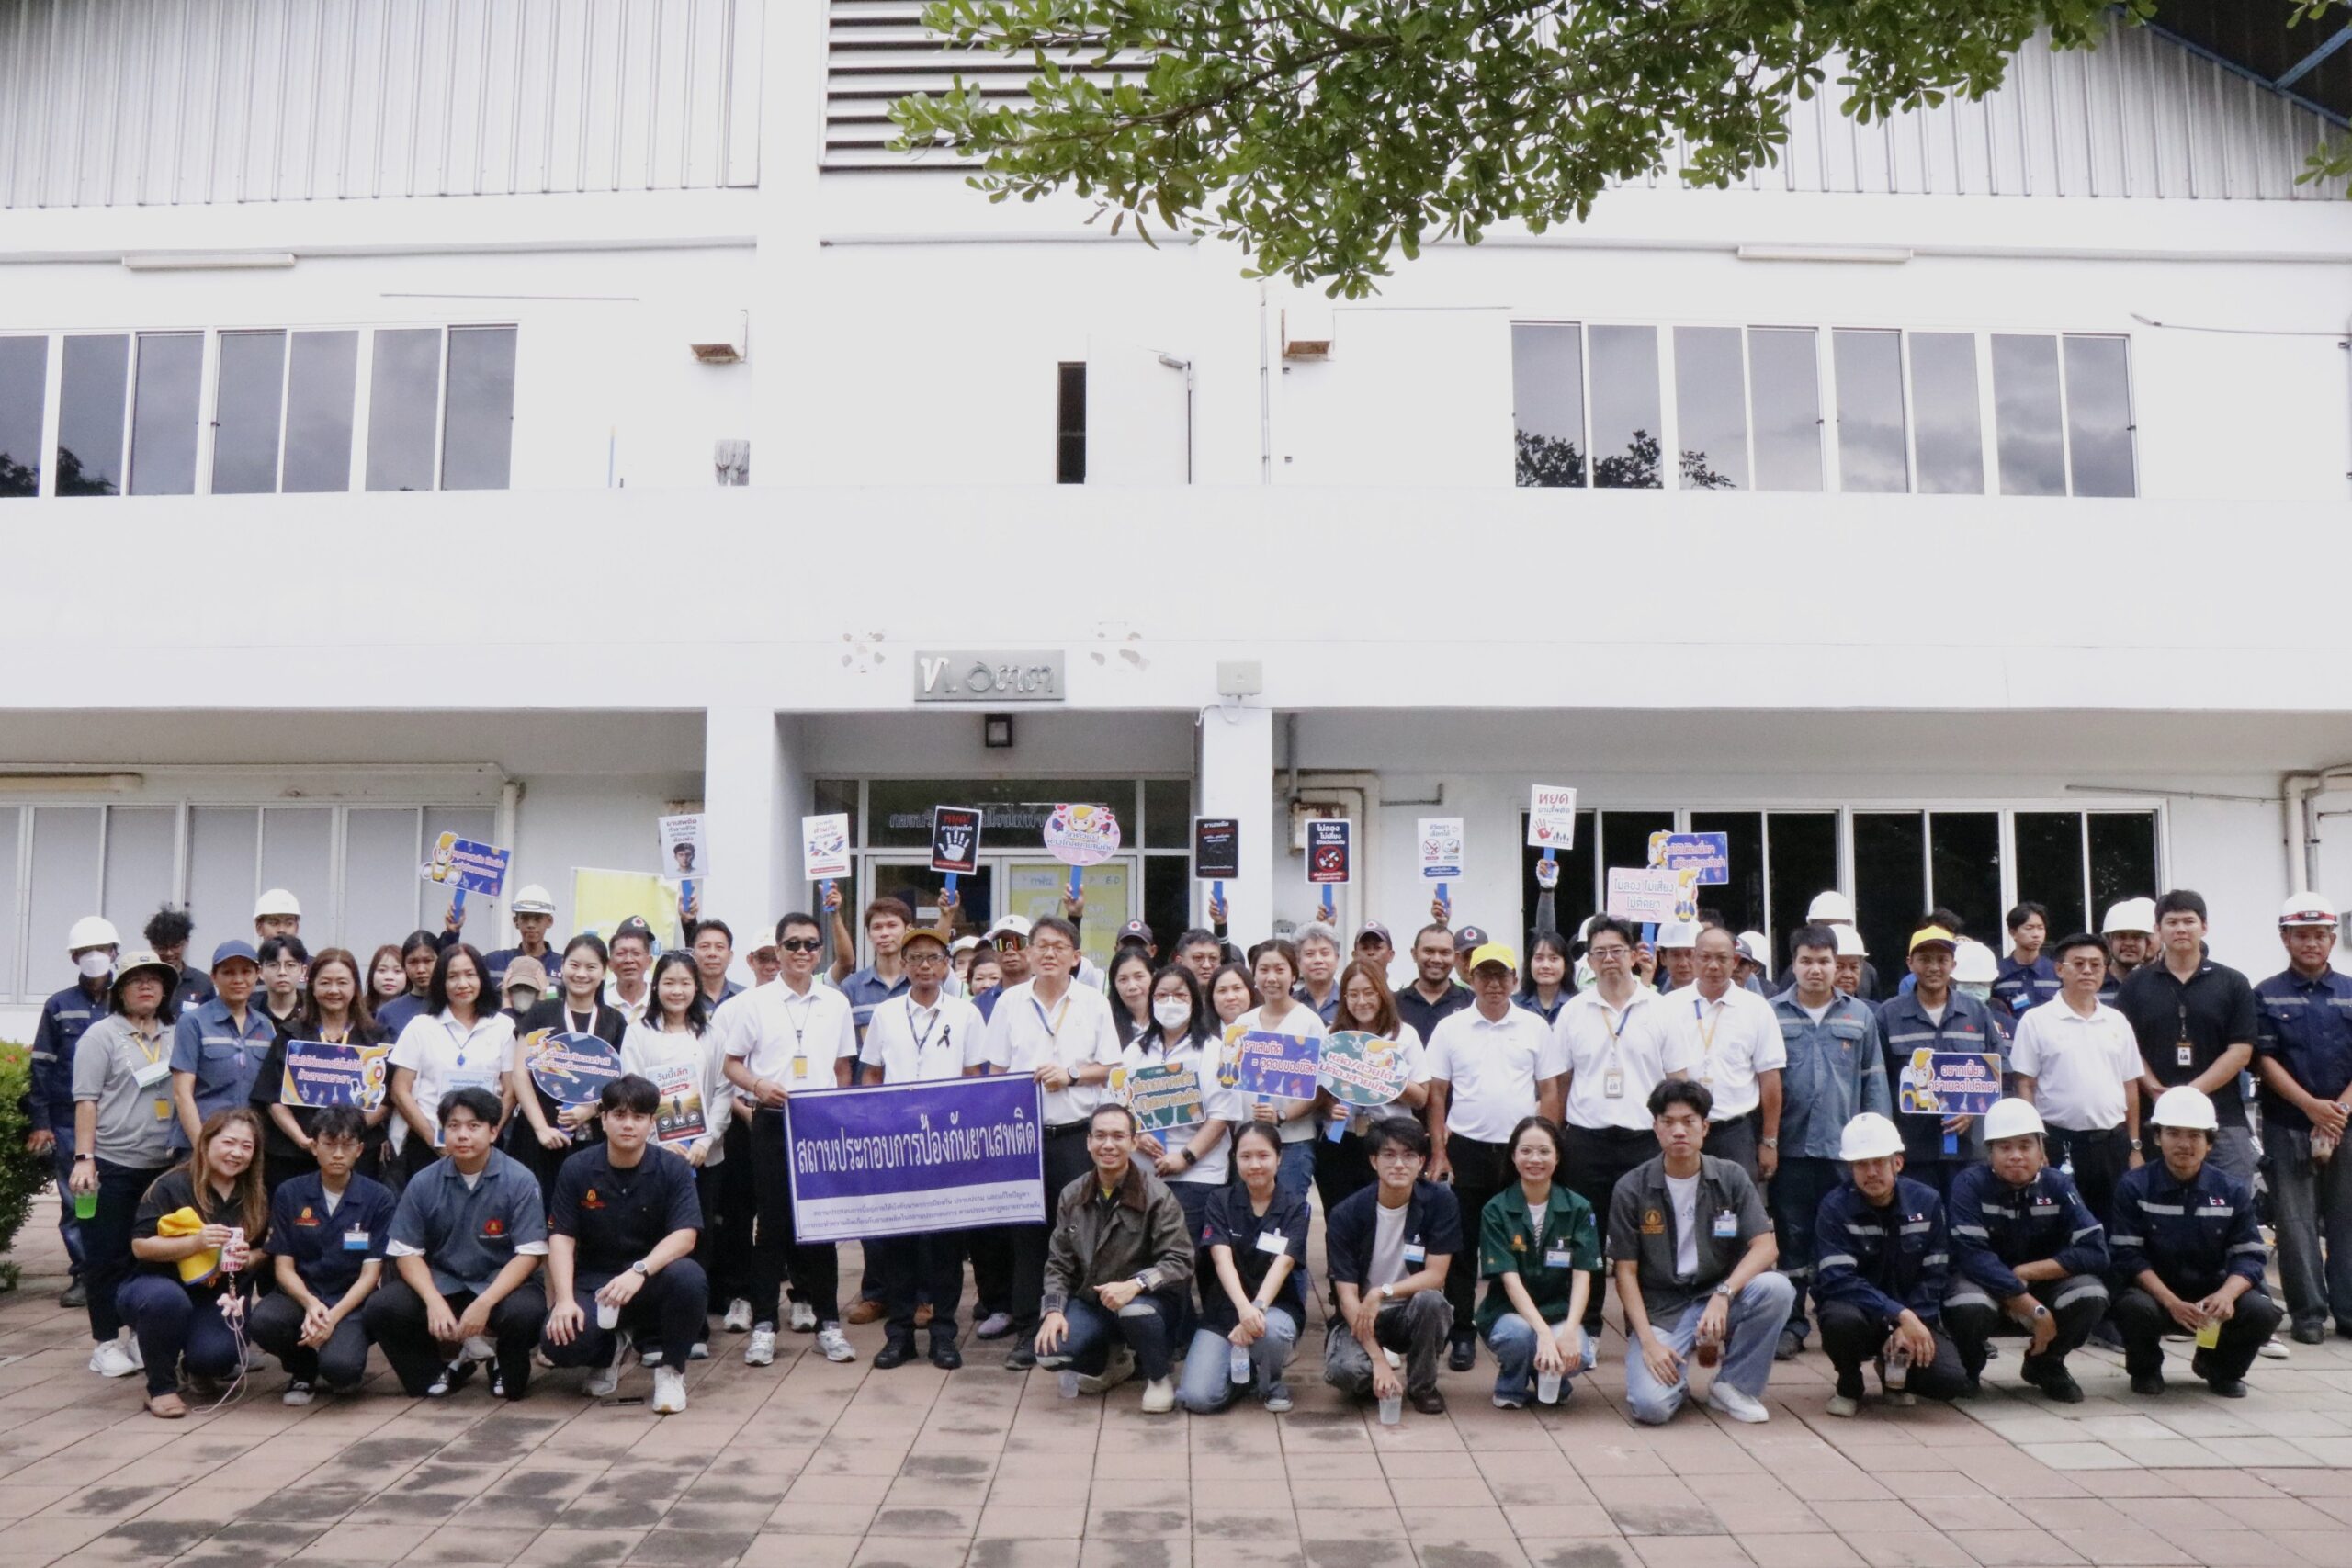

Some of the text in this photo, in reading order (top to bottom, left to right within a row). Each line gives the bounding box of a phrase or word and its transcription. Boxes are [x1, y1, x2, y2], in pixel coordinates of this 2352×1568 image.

[1539, 793, 1569, 807] หยุด
[941, 824, 973, 832] ยาเสพติด
[1614, 877, 1674, 892] ไม่ลอง ไม่เสี่ยง
[1626, 896, 1661, 908] ไม่ติดยา
[1244, 1040, 1283, 1056] ยาเสพติด
[657, 1067, 688, 1081] วันนี้เลิก
[1318, 1061, 1398, 1097] ม่ต้องสายเขียว
[1928, 1077, 1999, 1093] อย่าเผลอไปติดยา
[797, 1107, 1036, 1174] สถานประกอบการป้องกันยาเสพติด
